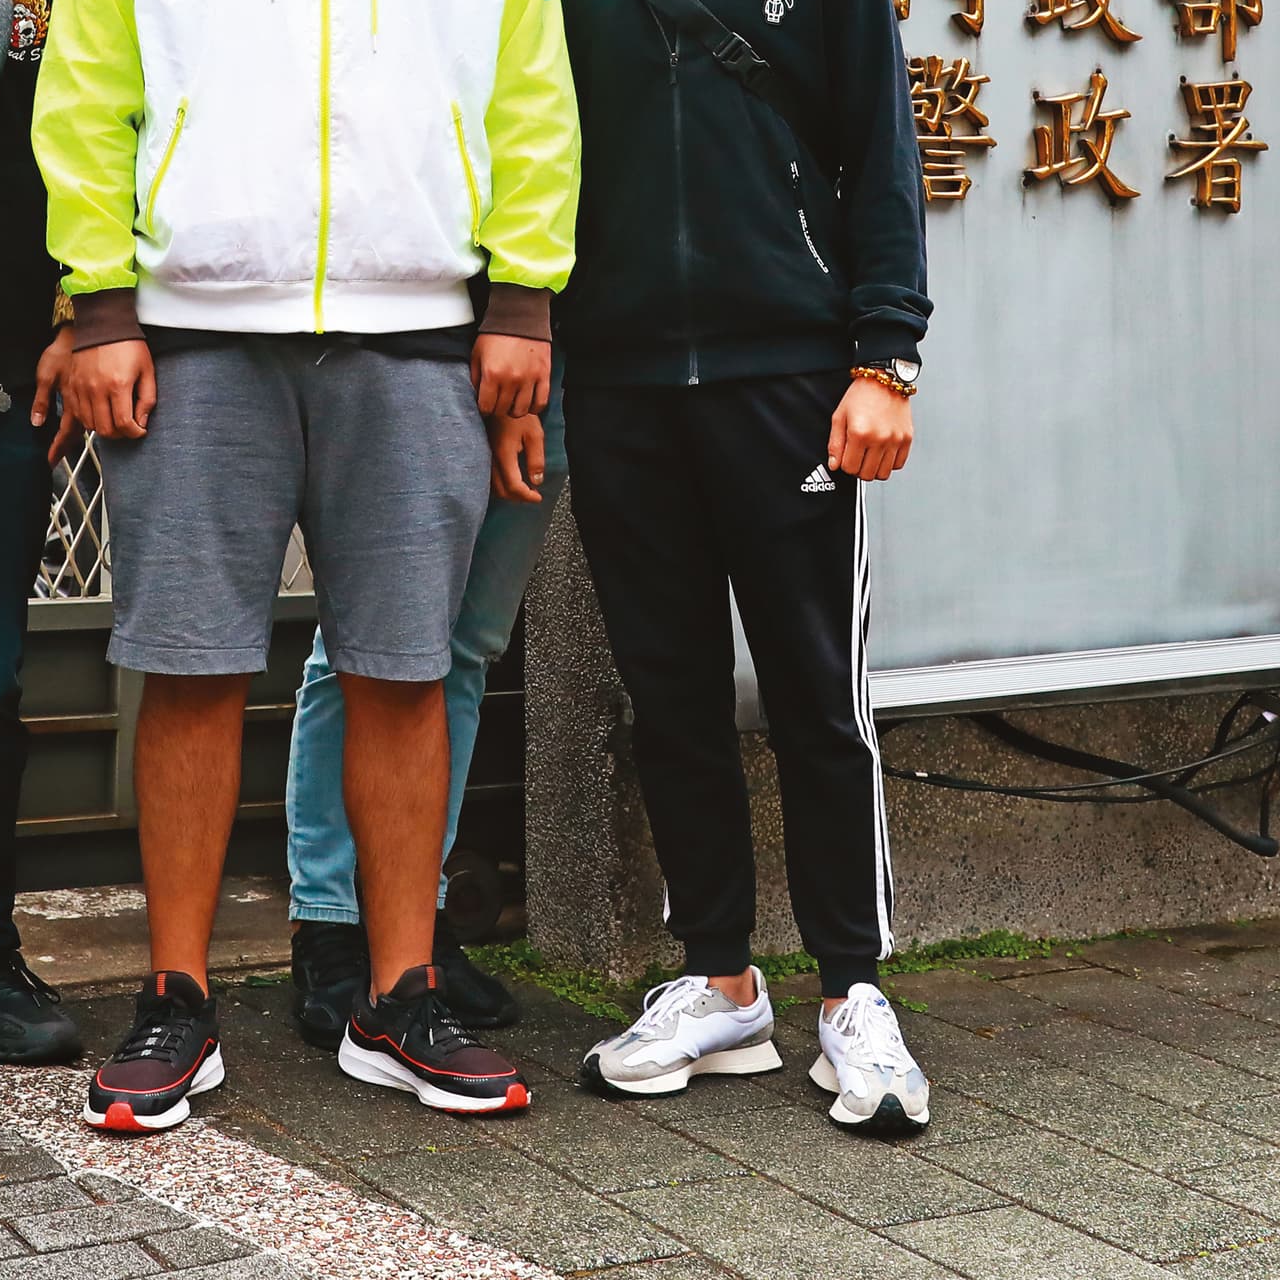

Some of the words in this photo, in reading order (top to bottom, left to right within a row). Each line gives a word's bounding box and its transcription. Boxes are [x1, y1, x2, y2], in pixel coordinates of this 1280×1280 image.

[906, 55, 1269, 213] 警政署
[800, 481, 836, 493] adidas
